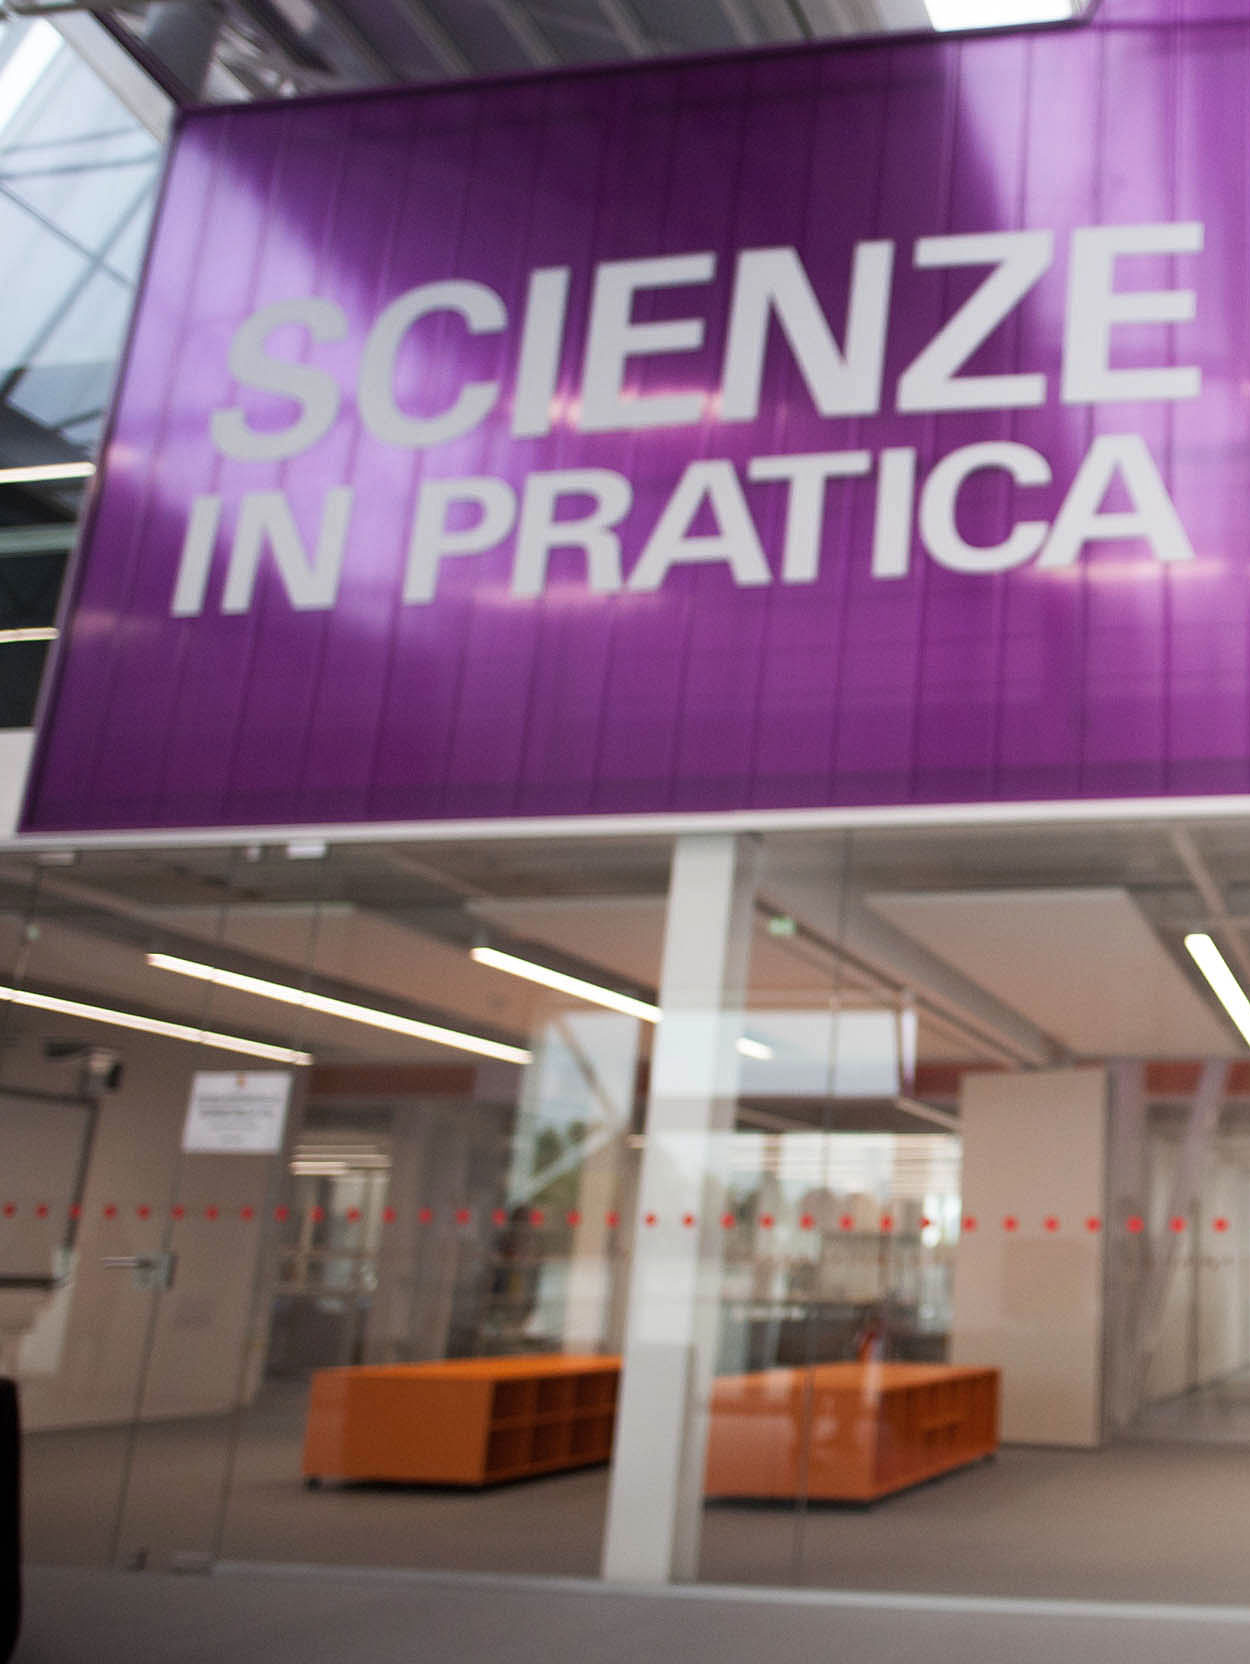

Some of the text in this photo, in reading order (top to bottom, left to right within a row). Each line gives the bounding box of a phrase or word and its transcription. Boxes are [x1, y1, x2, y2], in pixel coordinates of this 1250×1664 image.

[210, 220, 1204, 464] SCIENZE
[171, 432, 1196, 619] IN PRATICA
